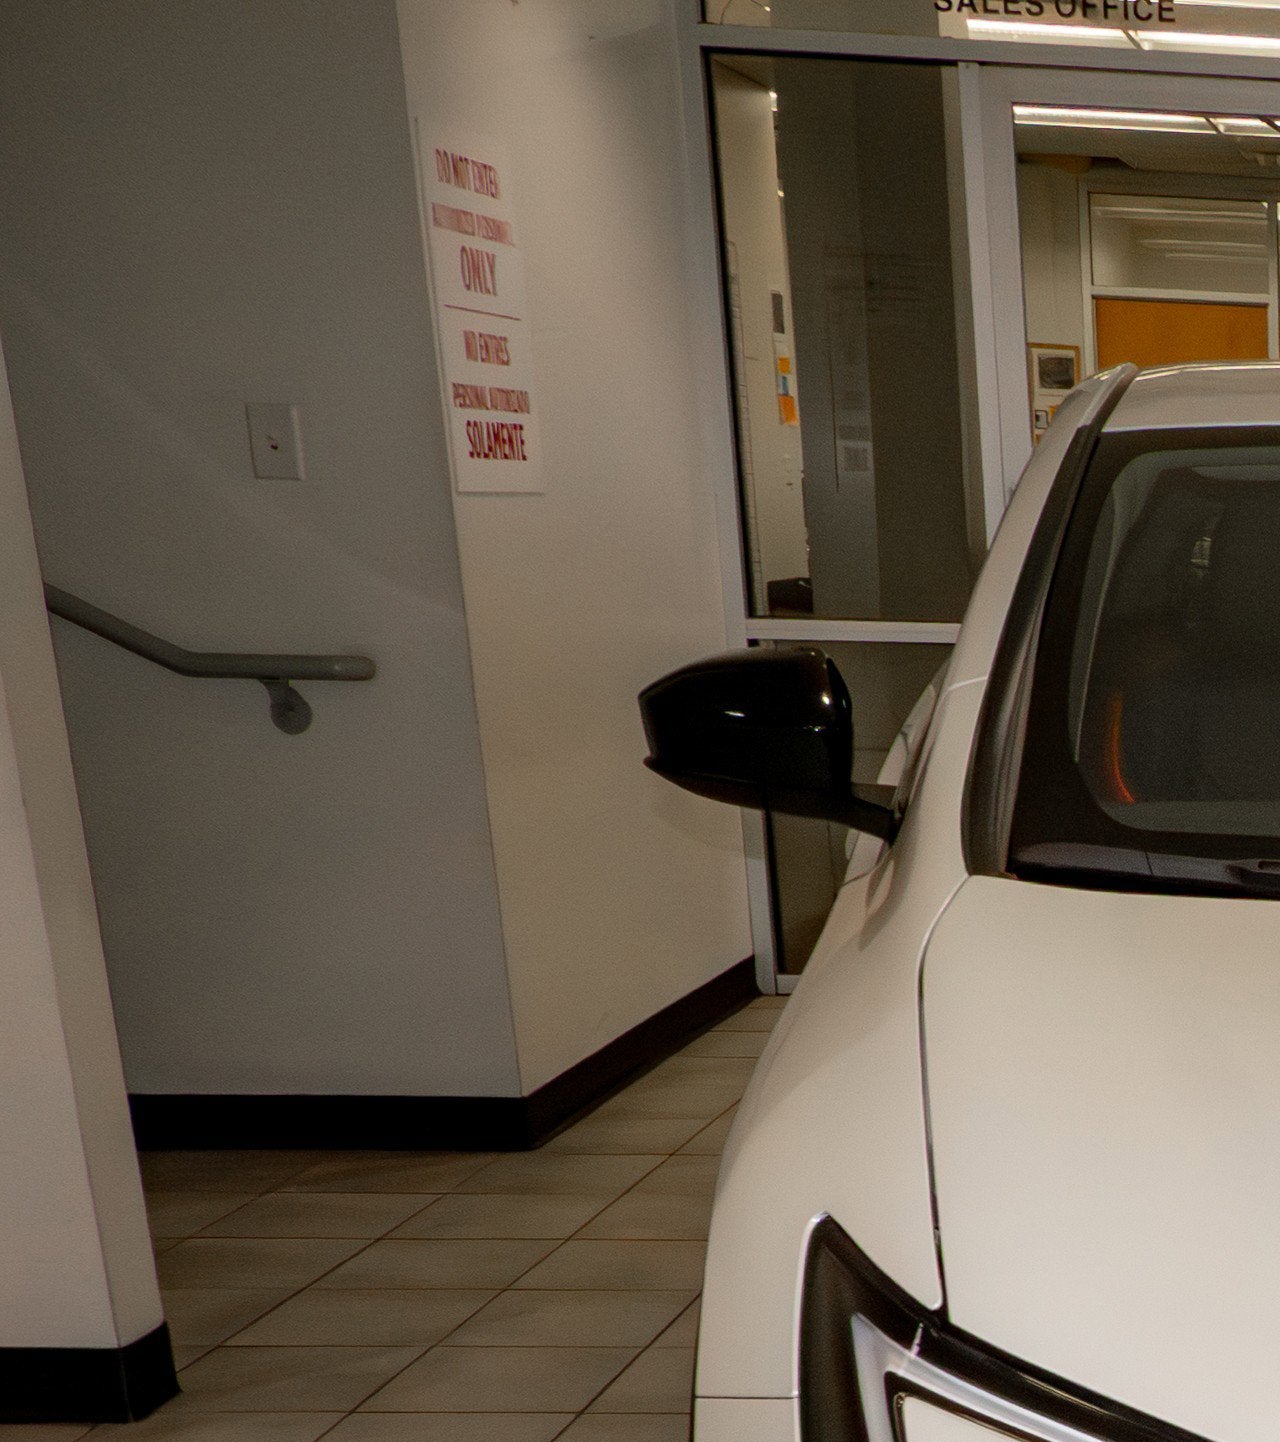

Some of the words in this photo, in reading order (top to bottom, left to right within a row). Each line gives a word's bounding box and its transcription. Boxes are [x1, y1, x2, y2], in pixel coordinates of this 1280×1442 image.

[1055, 0, 1176, 23] OFFICE
[460, 245, 498, 296] ONLY
[466, 419, 528, 461] SOLAMENTE
